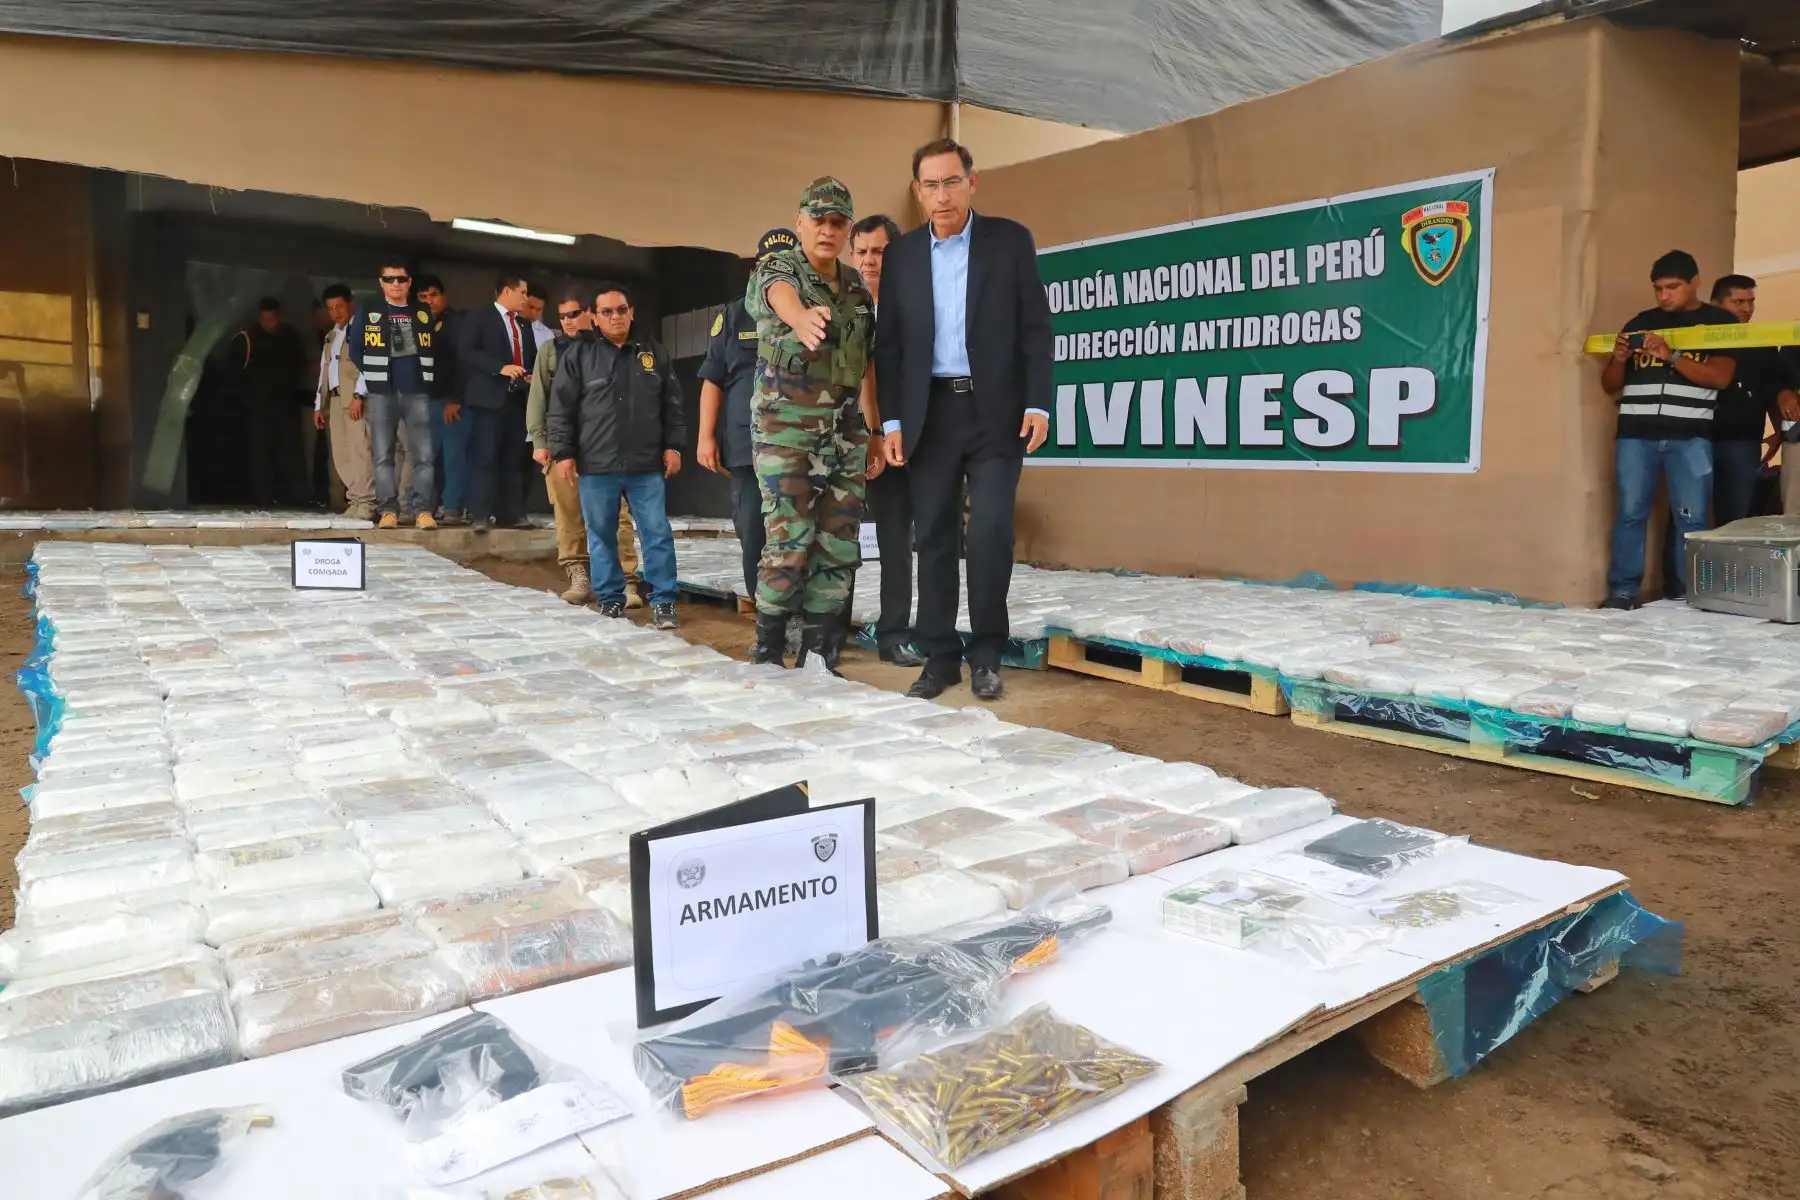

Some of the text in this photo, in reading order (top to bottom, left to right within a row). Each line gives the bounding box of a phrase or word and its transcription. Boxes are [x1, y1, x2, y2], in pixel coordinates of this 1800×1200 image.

[1421, 218, 1454, 228] DIRANDRO
[764, 234, 793, 248] POLICIA
[1044, 228, 1385, 314] OLICÍA NACIONAL DEL PERÚ
[364, 333, 385, 347] POL
[1054, 306, 1362, 362] DIRECCIÓN ANTIDROGAS
[1055, 366, 1436, 446] IVINESP
[308, 568, 348, 576] COMISADA
[679, 875, 838, 926] ARMAMENTO
